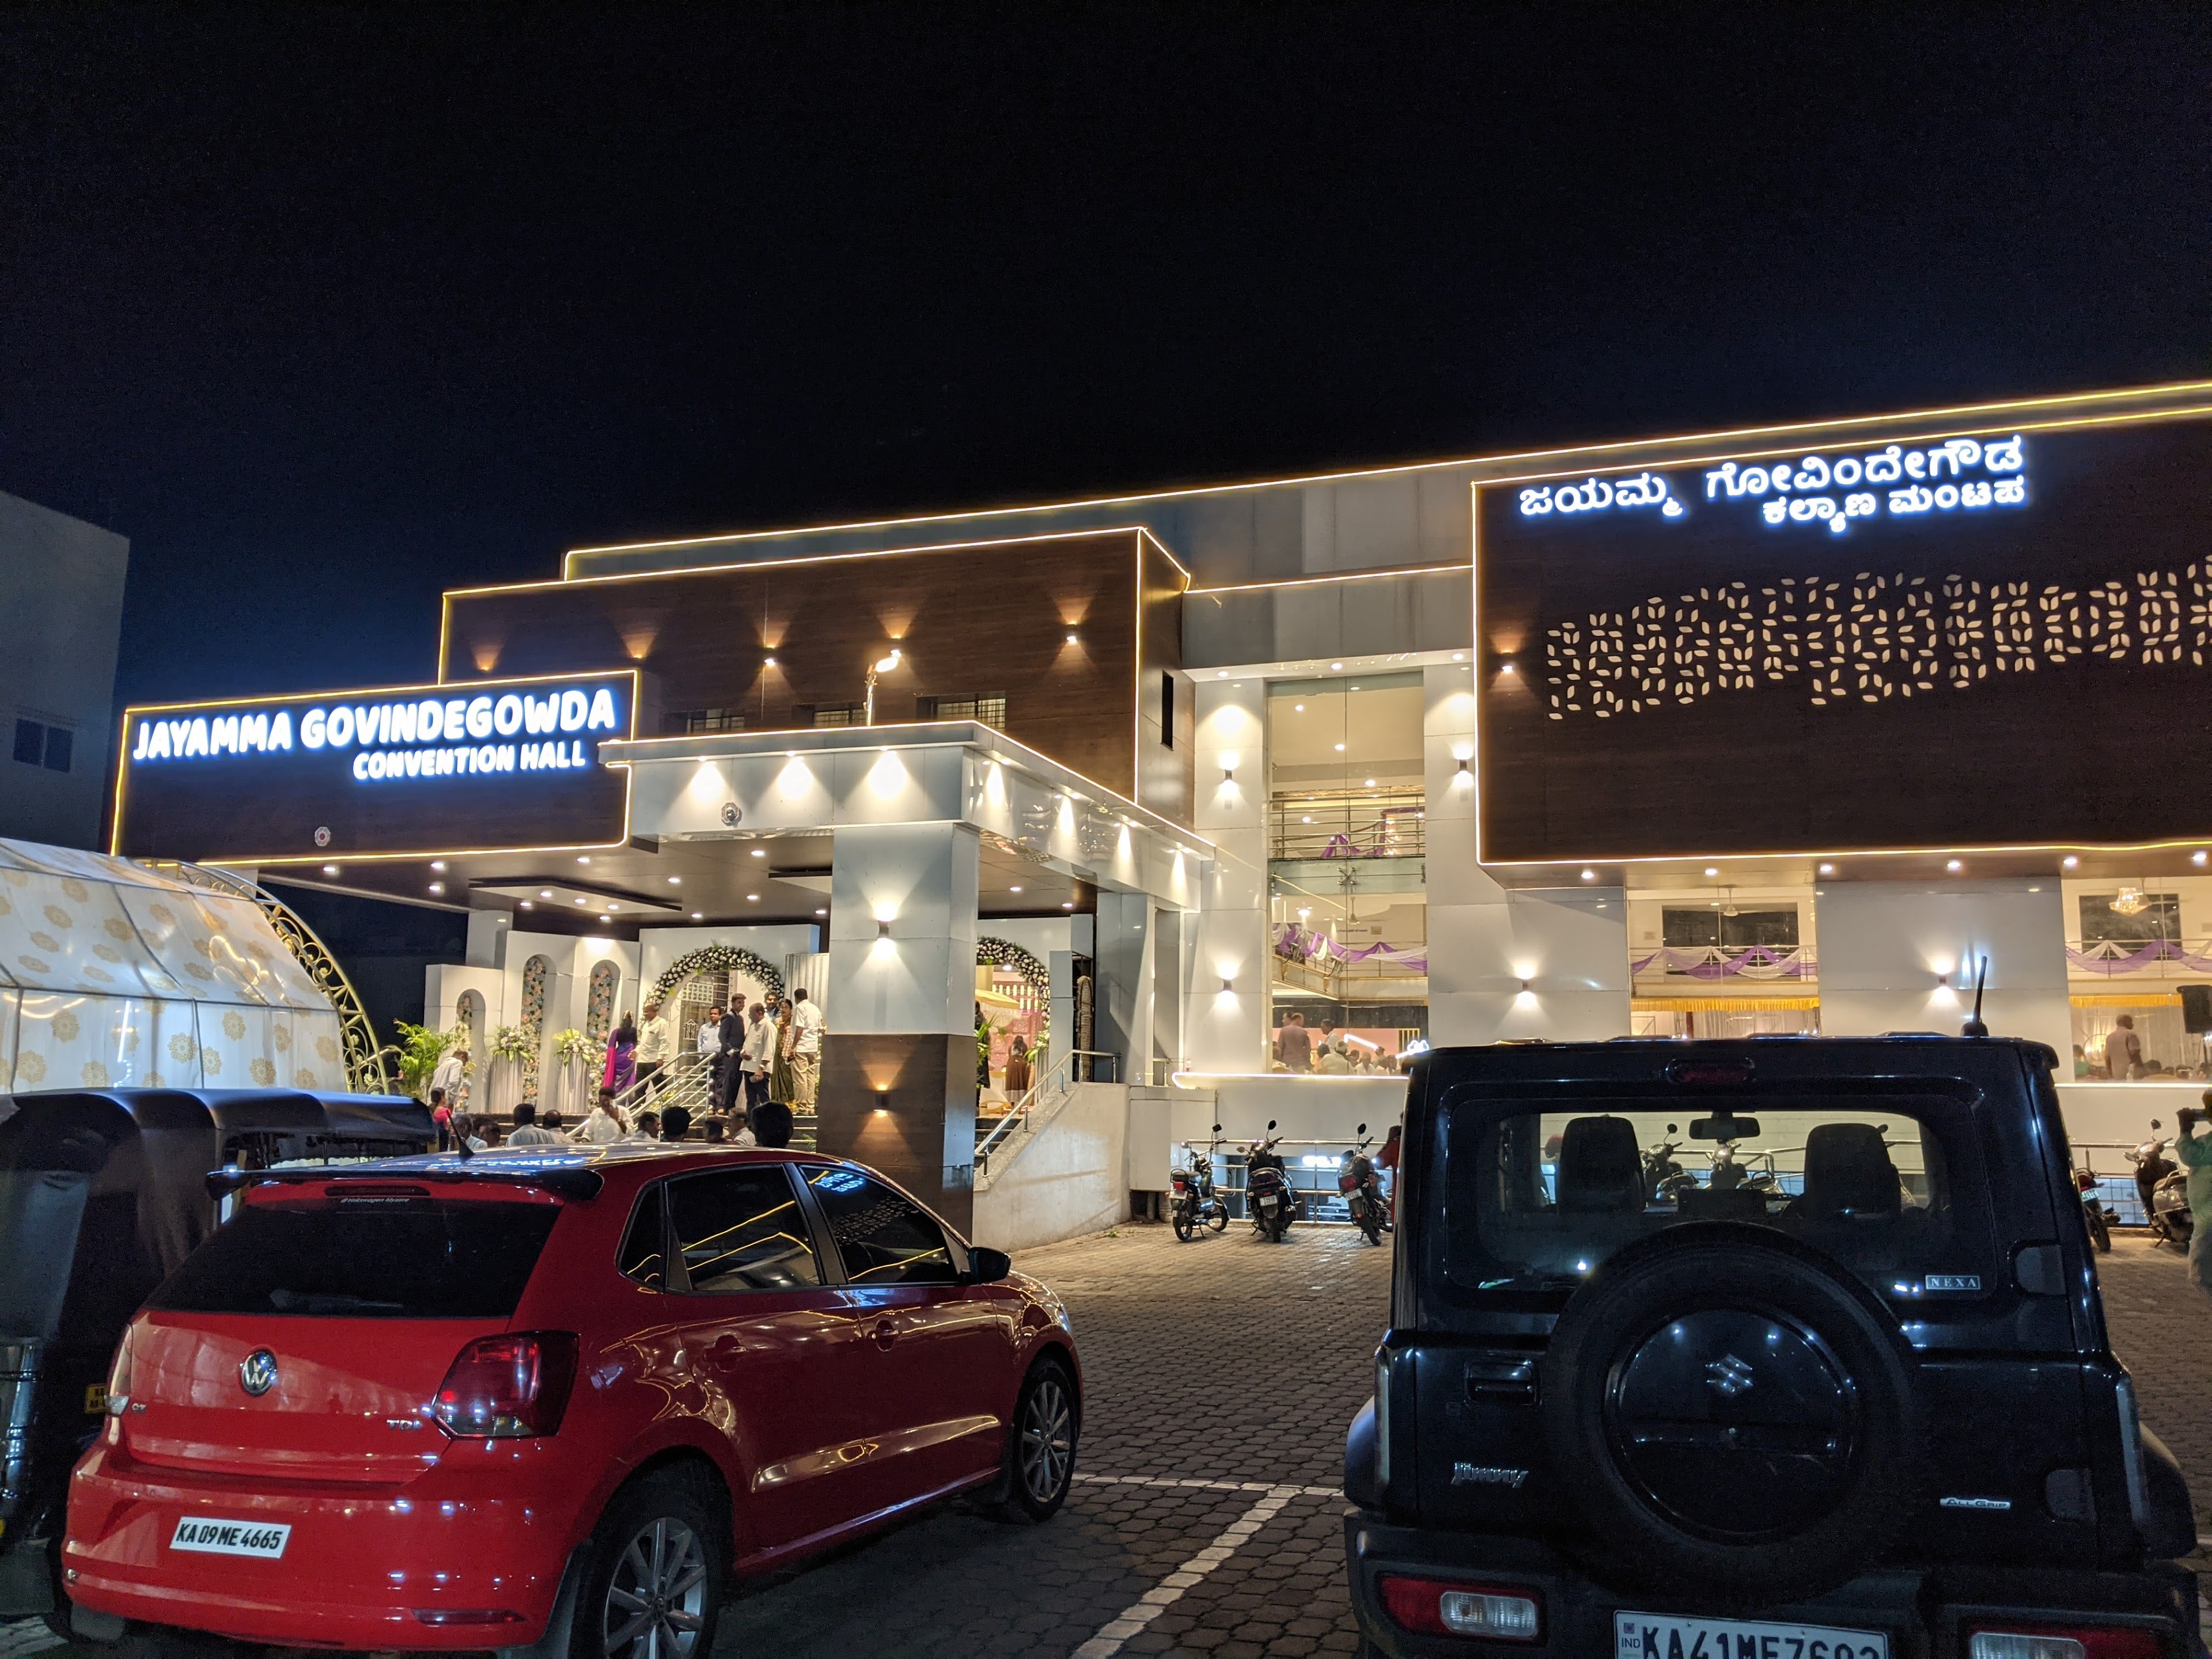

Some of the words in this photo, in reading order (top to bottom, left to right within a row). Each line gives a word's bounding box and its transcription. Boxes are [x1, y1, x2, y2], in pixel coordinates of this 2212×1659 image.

[1519, 471, 1684, 517] ಜಯಮ್ಮ
[1705, 434, 2024, 498] ಗೋವಿಂದೇಗೌಡ
[1762, 493, 1877, 533] ಕಲ್ಯಾಣ
[1888, 474, 2025, 514] ಮಂಟಪ
[132, 711, 292, 760] JAYAMMA
[300, 688, 616, 749] GOVINDEGOWDA
[352, 744, 516, 781] CONVENTION
[519, 740, 586, 771] HALL
[1931, 1278, 1977, 1287] NEXA
[1620, 1637, 1641, 1649] IND
